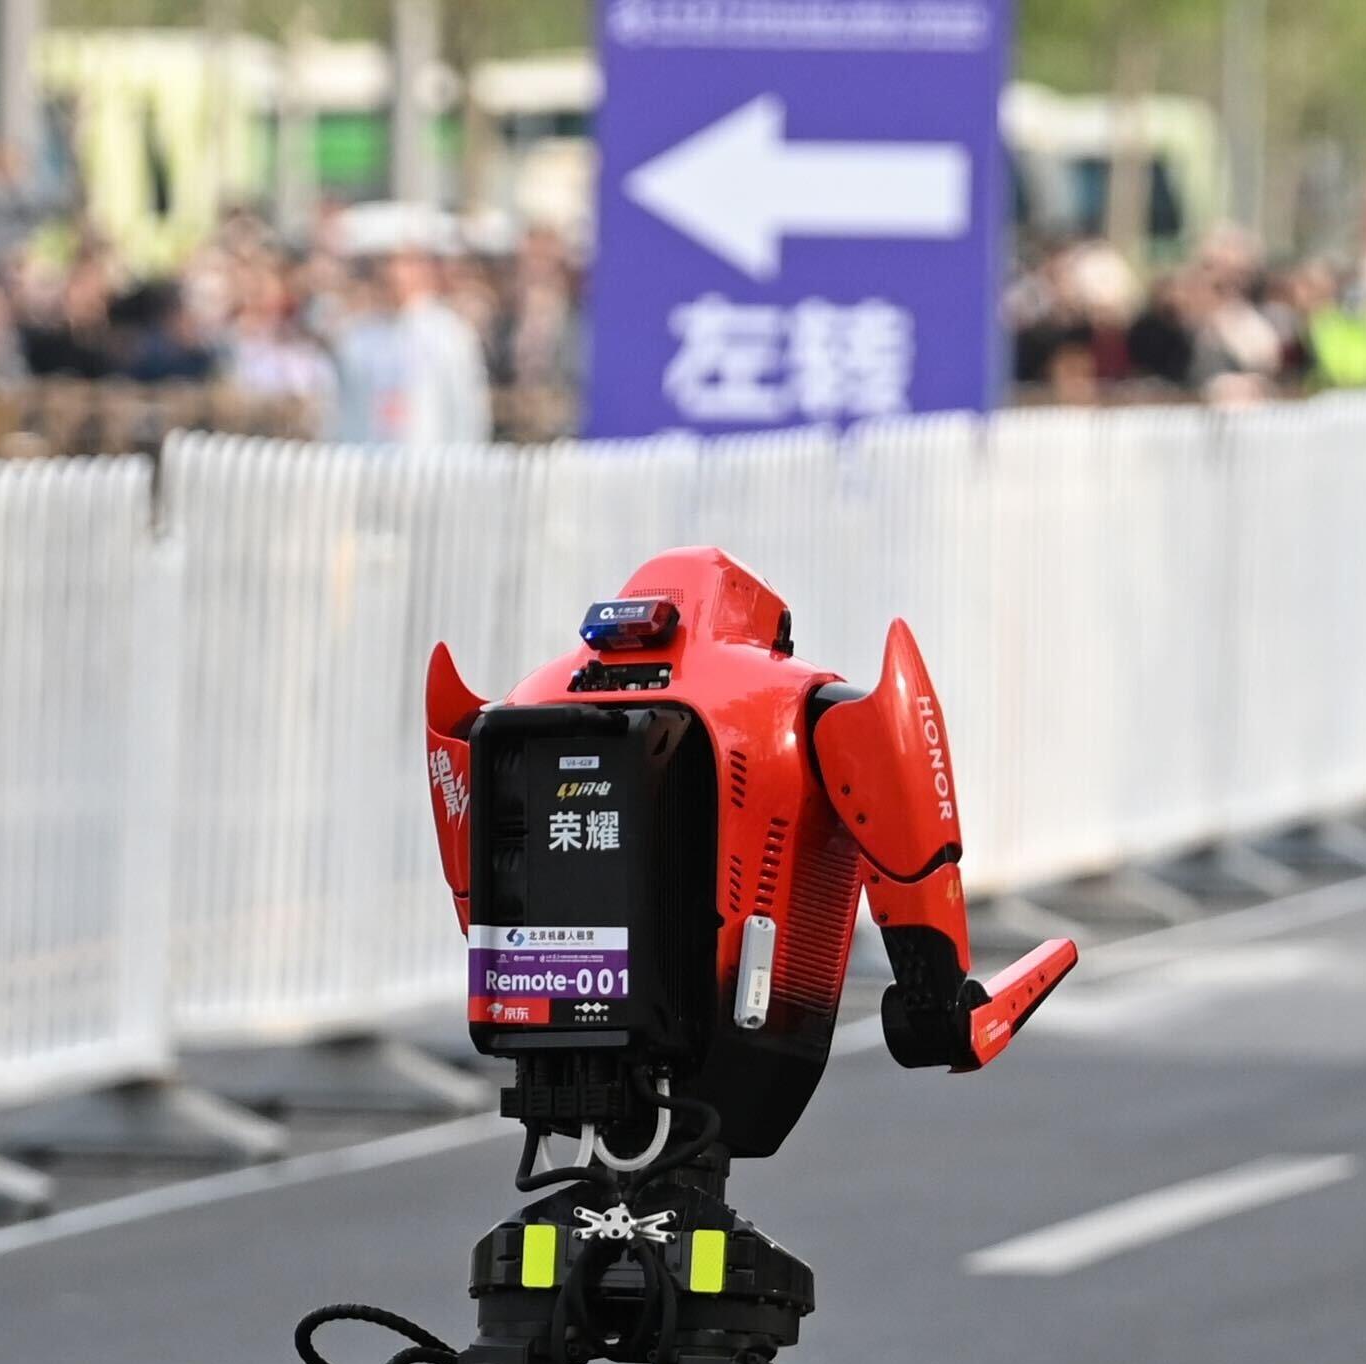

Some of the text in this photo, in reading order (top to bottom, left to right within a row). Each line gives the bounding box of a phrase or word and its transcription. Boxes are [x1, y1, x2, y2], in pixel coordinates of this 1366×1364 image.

[917, 695, 953, 821] HONOR
[576, 781, 611, 796] 闪电
[548, 810, 620, 852] 荣耀
[529, 929, 595, 941] 北京机器人租赁
[486, 968, 629, 995] Remote-001
[504, 1006, 529, 1021] 京东
